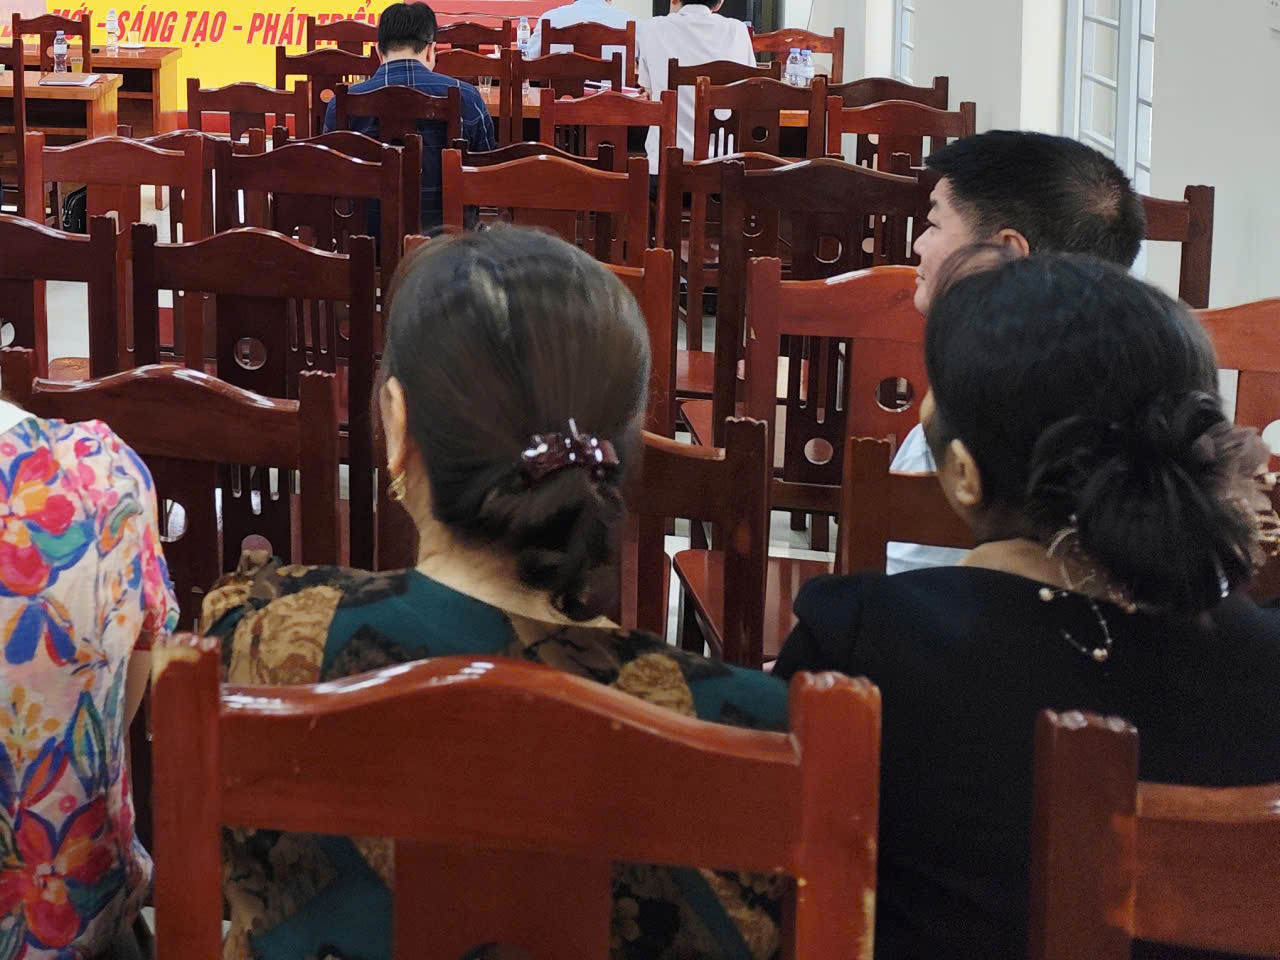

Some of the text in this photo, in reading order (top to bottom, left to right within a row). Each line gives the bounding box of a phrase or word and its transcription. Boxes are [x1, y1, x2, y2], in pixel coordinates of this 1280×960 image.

[118, 5, 178, 42] SÁNG
[182, 10, 228, 48] TẠO
[247, 6, 309, 46] PHÁT
